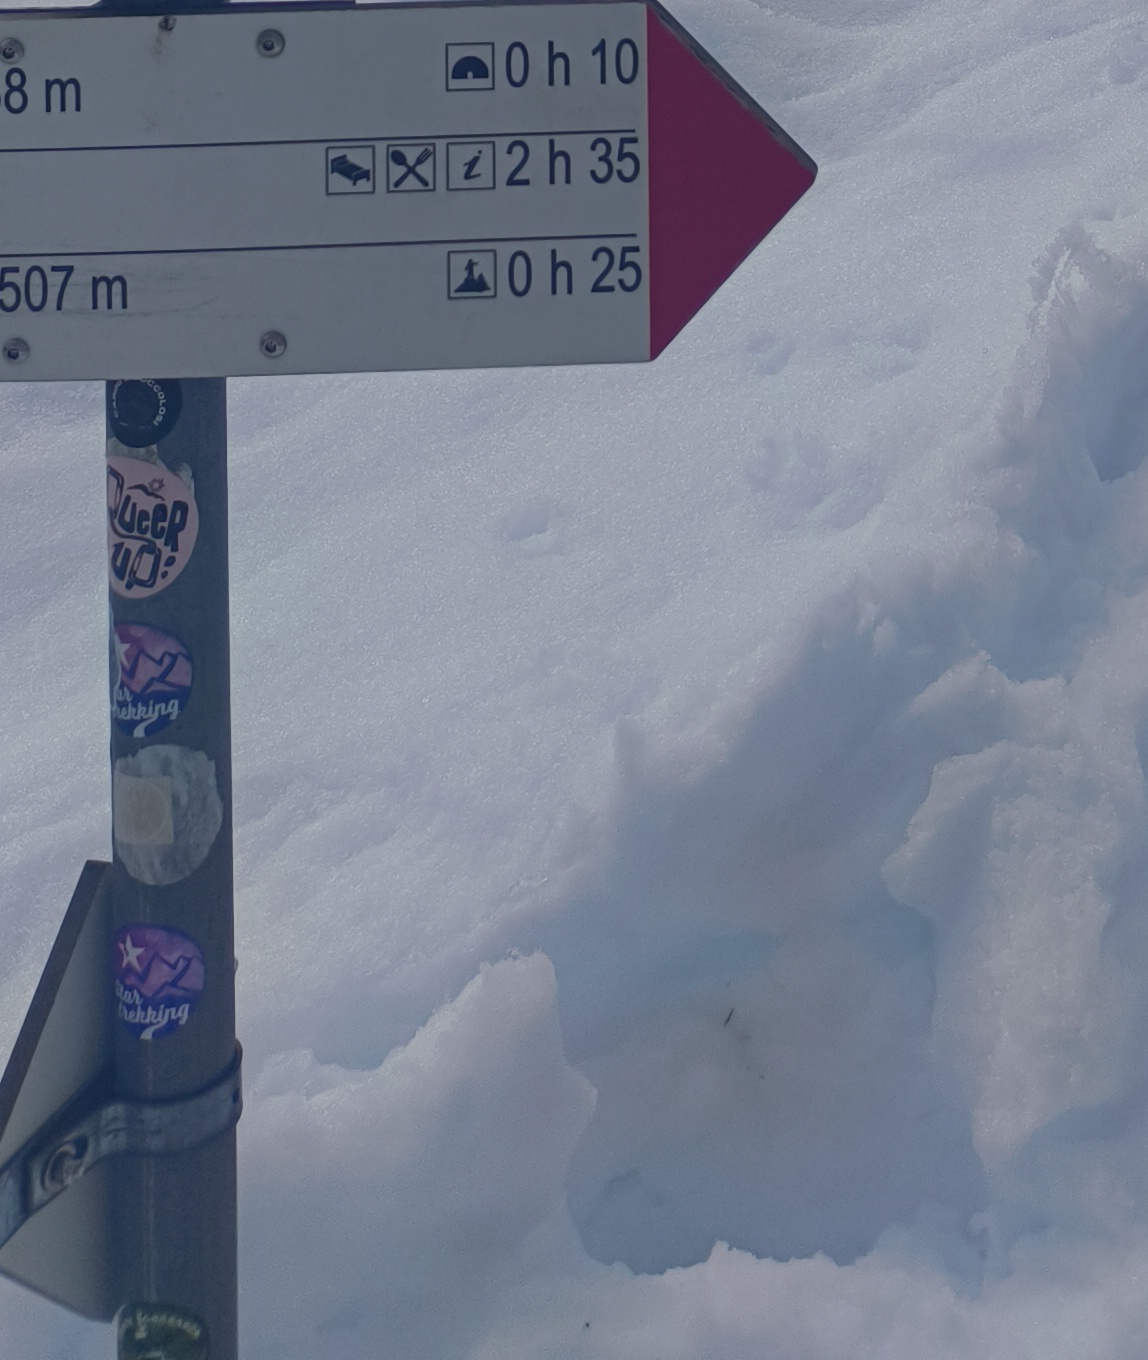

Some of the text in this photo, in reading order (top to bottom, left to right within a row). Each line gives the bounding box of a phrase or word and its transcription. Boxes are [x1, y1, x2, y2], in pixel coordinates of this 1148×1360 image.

[0, 38, 640, 114] 8 m 0 h 10
[506, 137, 640, 186] 2 h 35
[91, 275, 128, 310] m
[508, 250, 532, 297] 0
[551, 248, 573, 295] h
[591, 246, 642, 292] 25
